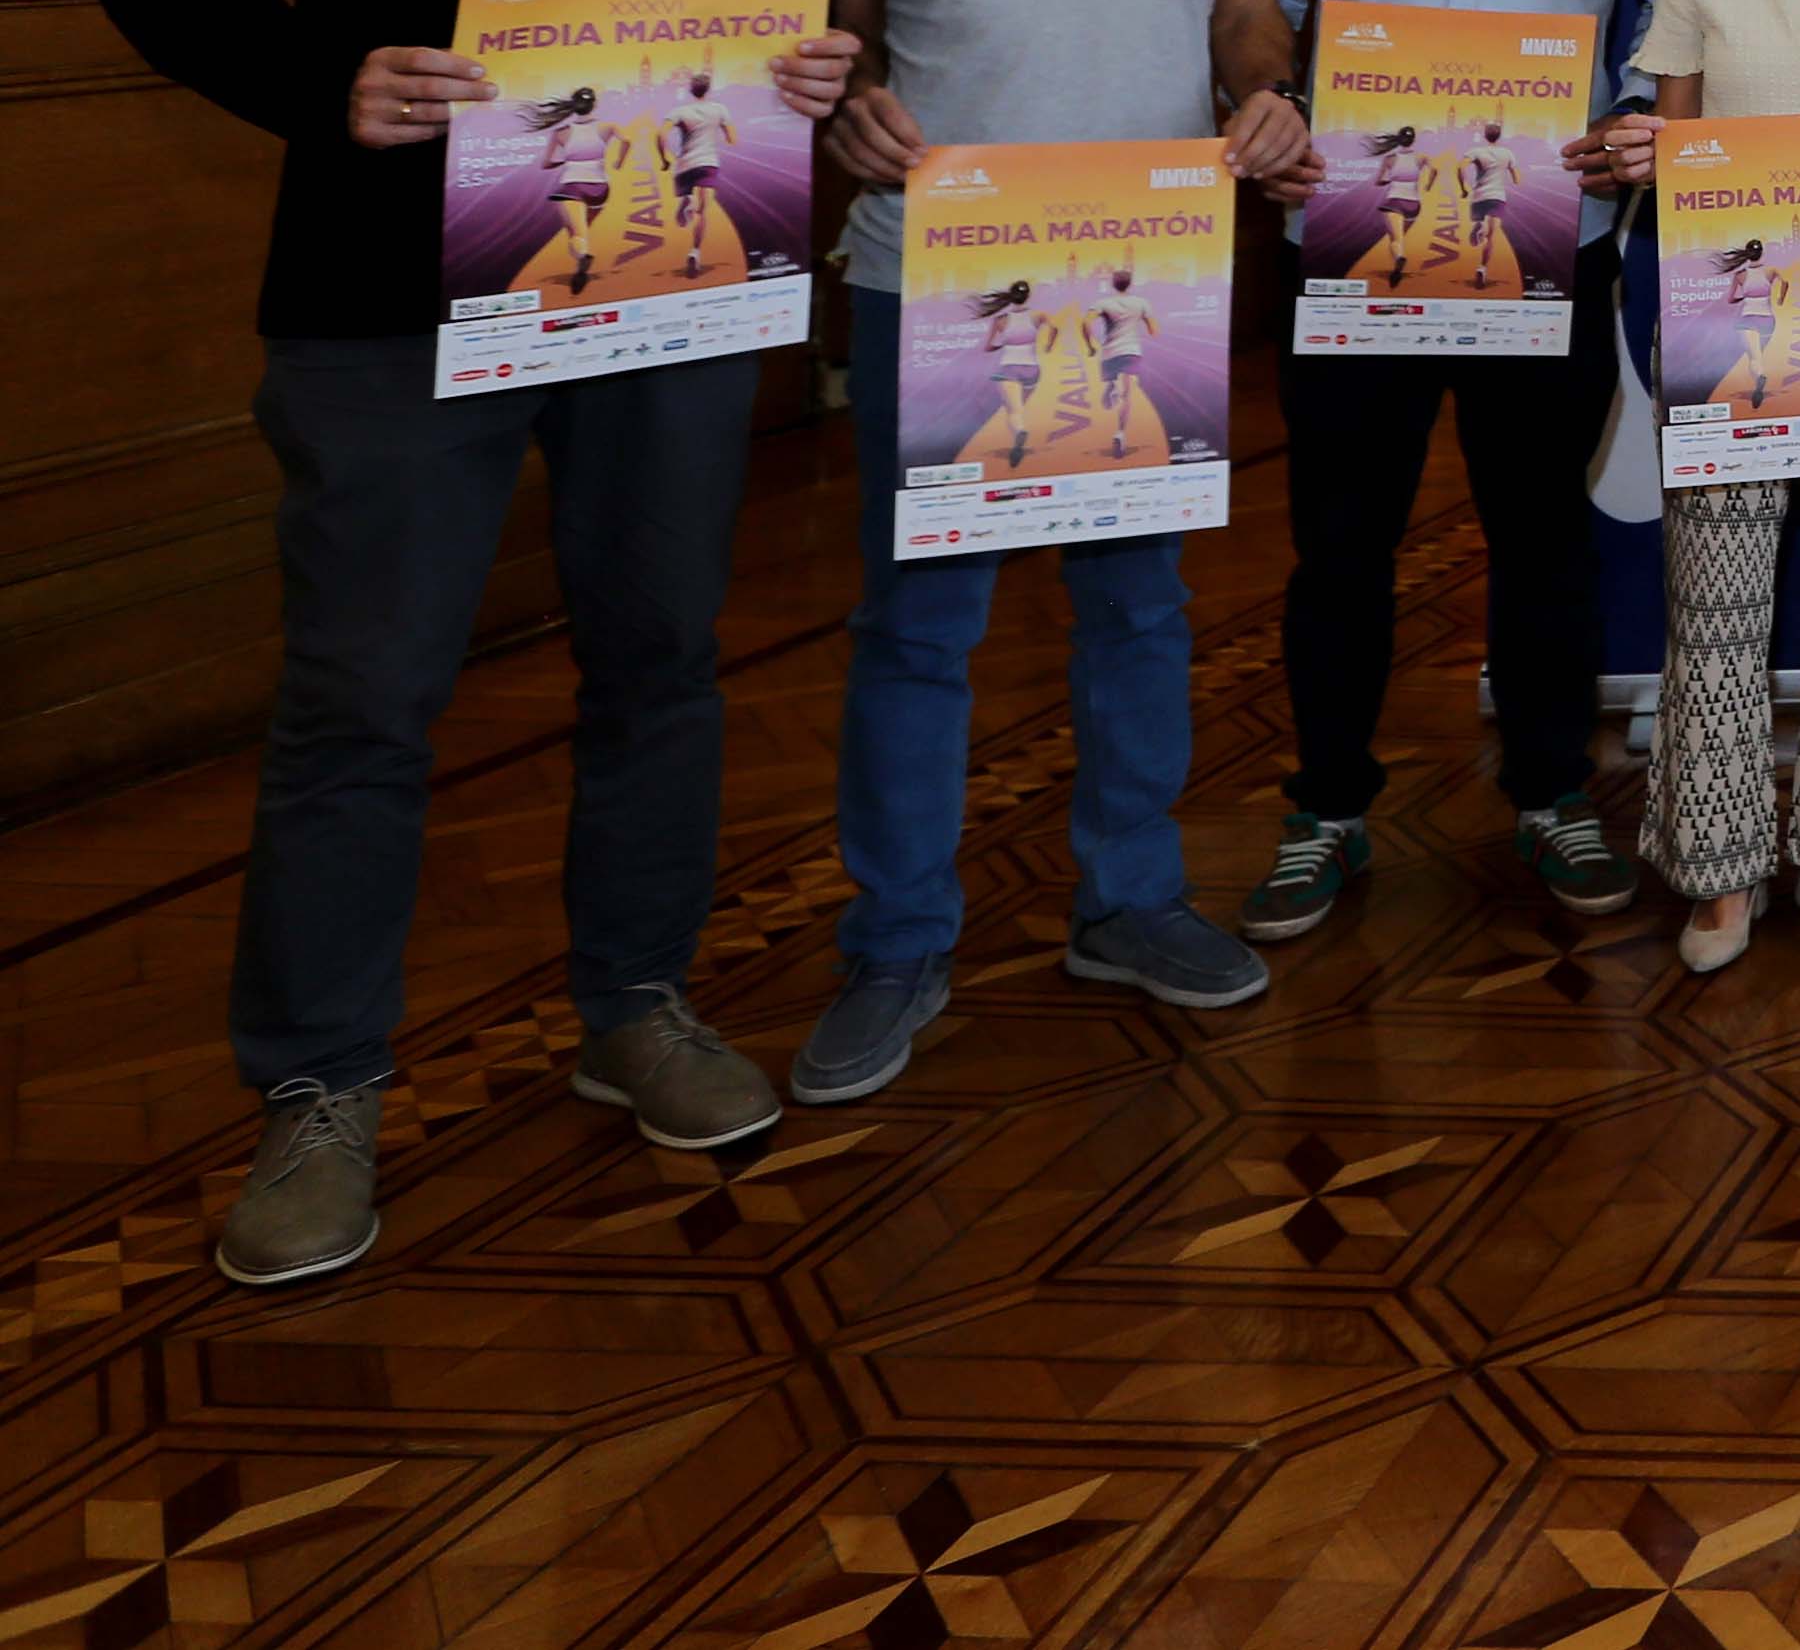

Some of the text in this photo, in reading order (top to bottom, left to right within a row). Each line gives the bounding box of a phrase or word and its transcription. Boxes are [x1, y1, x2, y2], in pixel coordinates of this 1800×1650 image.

[608, 0, 683, 17] XXXVI
[477, 8, 805, 55] MEDIA MARATÓN
[1520, 38, 1577, 56] MMVA25
[1332, 71, 1573, 98] MEDIA MARATÓN
[459, 151, 536, 170] Popular
[1150, 167, 1217, 189] MMVA25
[1674, 188, 1765, 211] MEDIA
[926, 210, 1213, 248] MEDIA MARATÓN
[1689, 276, 1730, 291] Legua
[1670, 289, 1724, 304] Popular
